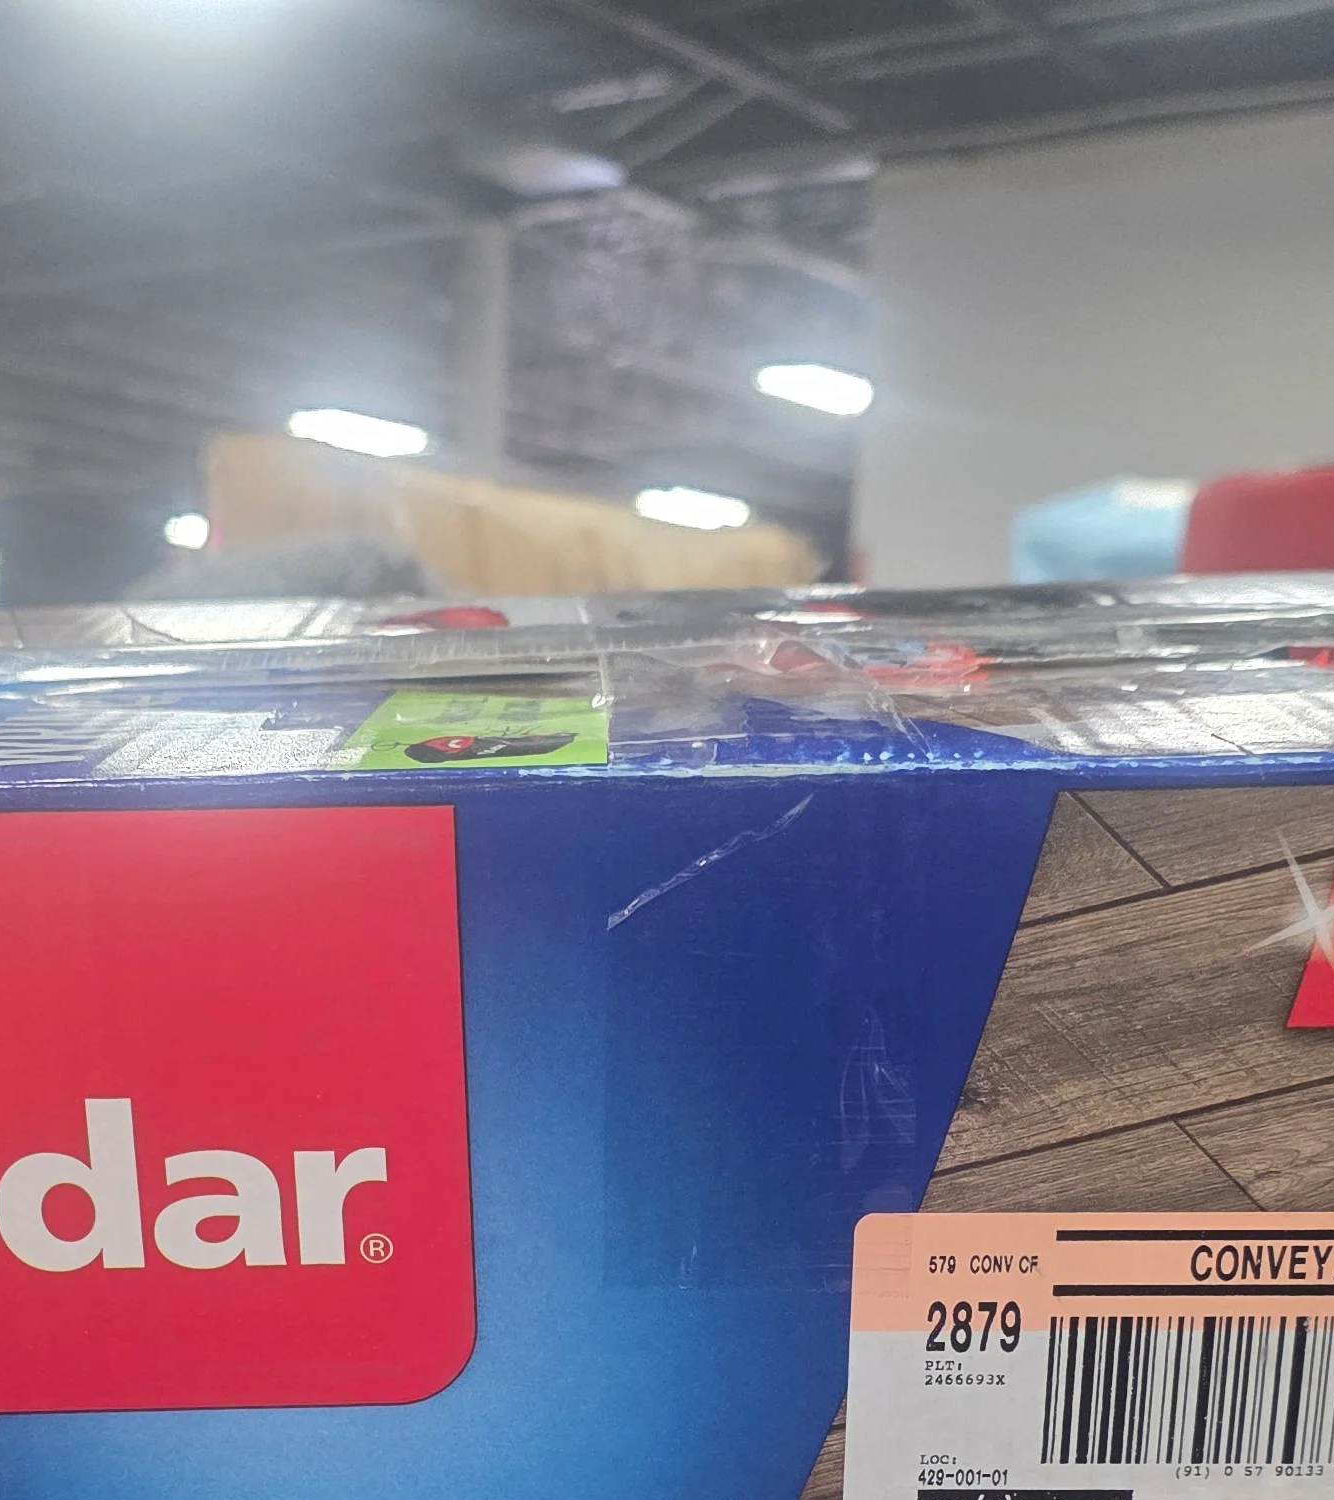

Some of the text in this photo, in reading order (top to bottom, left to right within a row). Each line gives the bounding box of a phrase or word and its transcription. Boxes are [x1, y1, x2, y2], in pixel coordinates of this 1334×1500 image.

[929, 1254, 956, 1274] 579
[970, 1253, 1014, 1275] CONV
[925, 1300, 1022, 1353] 2879
[925, 1360, 962, 1371] PLT:
[925, 1374, 1006, 1386] 2466693X
[920, 1454, 957, 1466] LOC:
[918, 1468, 1009, 1487] 429-001-01
[1175, 1466, 1211, 1479] (91)
[1224, 1466, 1233, 1477] 0
[1244, 1466, 1264, 1477] 57
[1274, 1466, 1324, 1477] 90133
